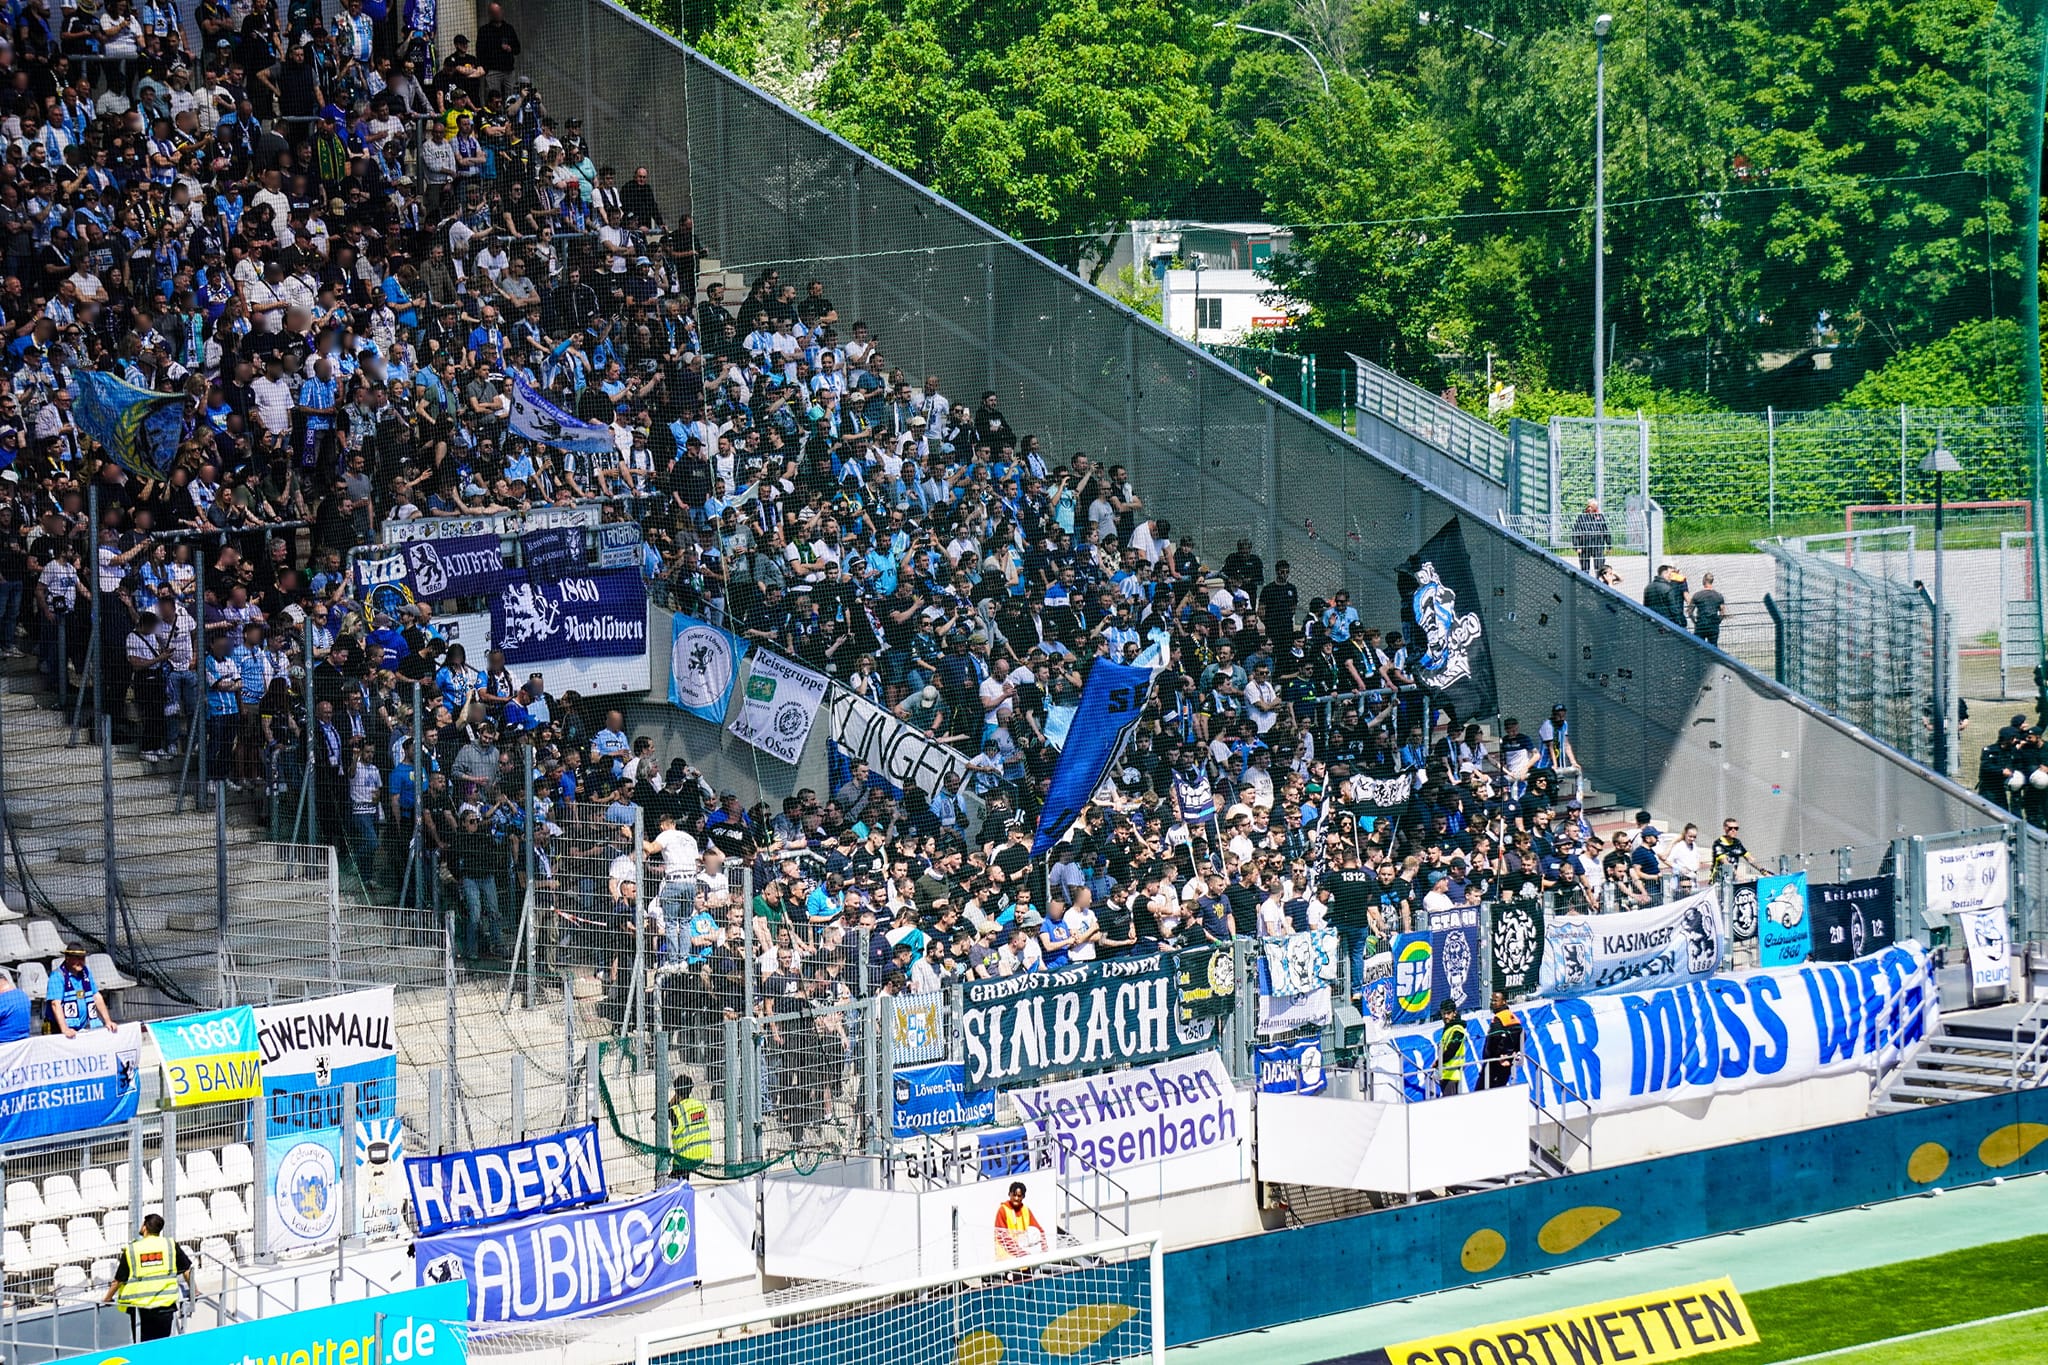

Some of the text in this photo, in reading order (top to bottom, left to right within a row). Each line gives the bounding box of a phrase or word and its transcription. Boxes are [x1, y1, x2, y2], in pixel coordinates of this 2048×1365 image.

[558, 577, 600, 602] 1860
[564, 614, 644, 642] Nordlöwen
[756, 651, 825, 692] Reisegruppe
[1341, 871, 1366, 882] 1312
[1603, 926, 1675, 955] KASINGER
[1778, 945, 1801, 960] 1860
[969, 953, 1162, 1002] GRENZSTADT LÖWEN
[1692, 959, 1713, 972] 1860
[177, 1017, 242, 1051] 1860
[258, 1012, 394, 1066] ÖWENMAUL
[963, 976, 1171, 1085] SIMBACH
[1389, 945, 1927, 1110] BER MUSS WEG
[272, 1077, 381, 1131] COBUG
[914, 1079, 964, 1098] Löwen-Fan
[1015, 1064, 1223, 1132] Vierkirchen
[1056, 1099, 1237, 1176] Pasenbach
[408, 1131, 602, 1228] HADERN
[474, 1209, 655, 1322] AUBING
